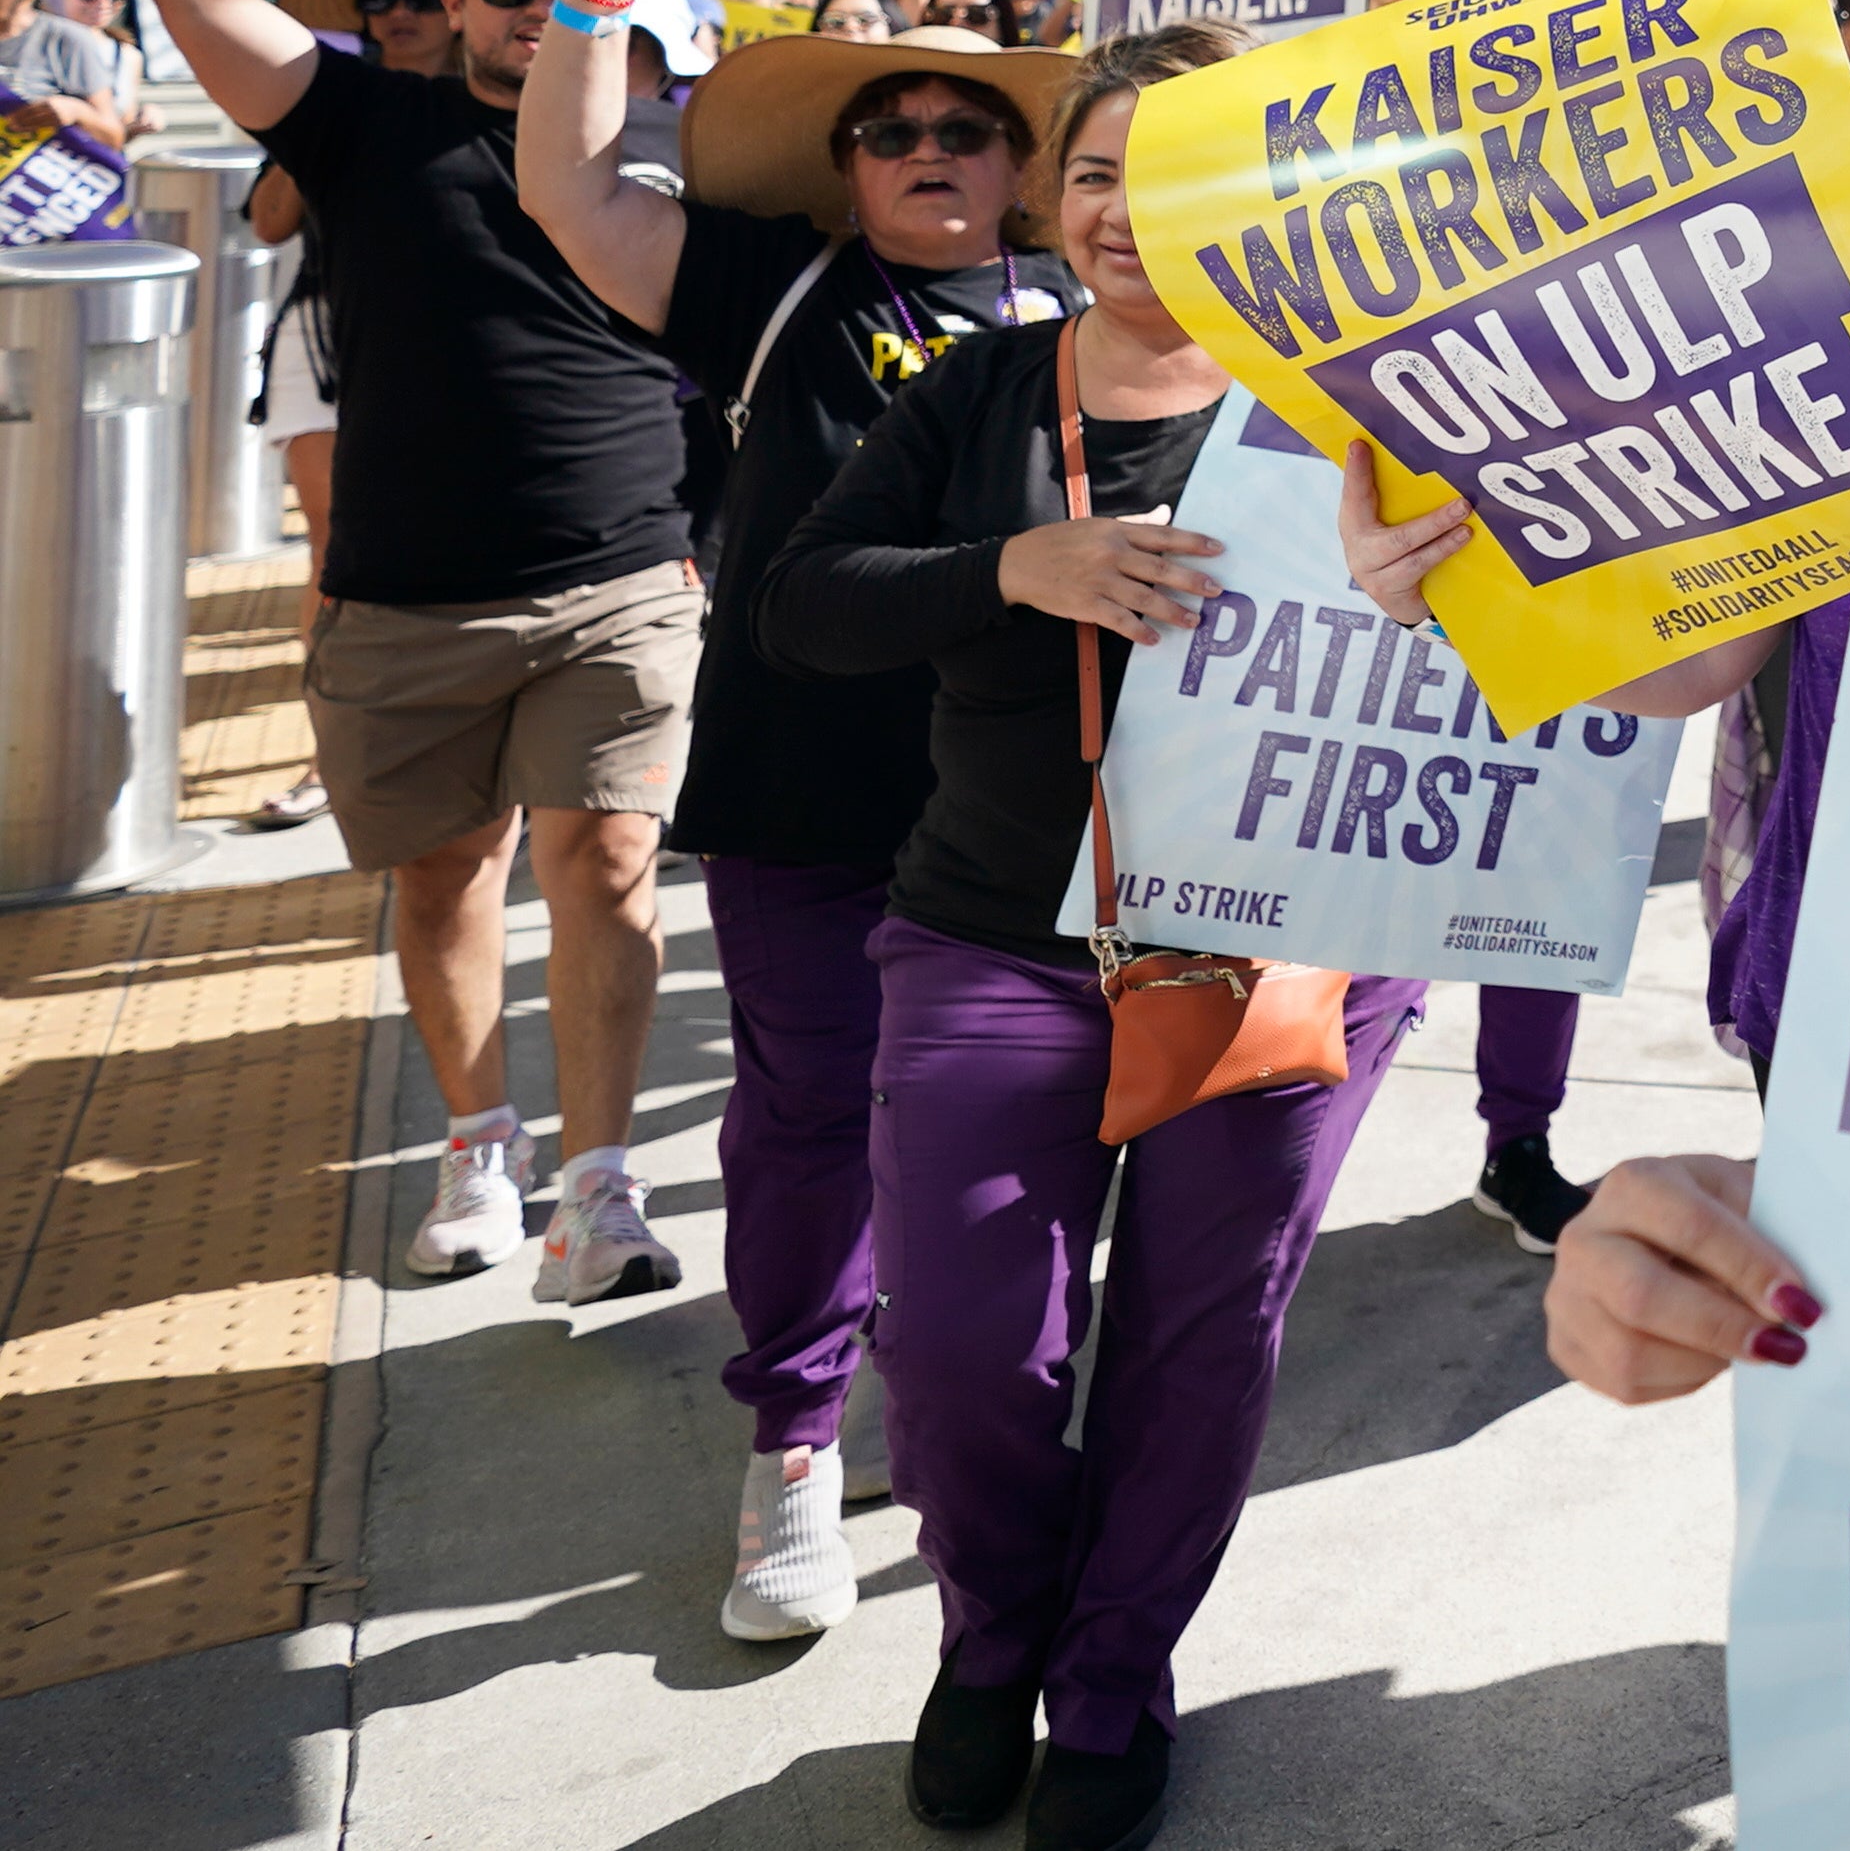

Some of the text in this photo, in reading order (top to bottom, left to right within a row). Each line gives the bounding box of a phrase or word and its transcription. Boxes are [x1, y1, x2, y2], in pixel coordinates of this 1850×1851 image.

[1196, 27, 1807, 358] WORKERS
[1370, 203, 1774, 455] ON ULP
[1670, 530, 1840, 593] #UNITED4ALL
[1234, 730, 1540, 871] FIRST
[1173, 881, 1289, 927] STRIKE
[1448, 914, 1548, 938] #UNITED4ALL
[1443, 933, 1599, 962] #SOLIDARITYSEASON
